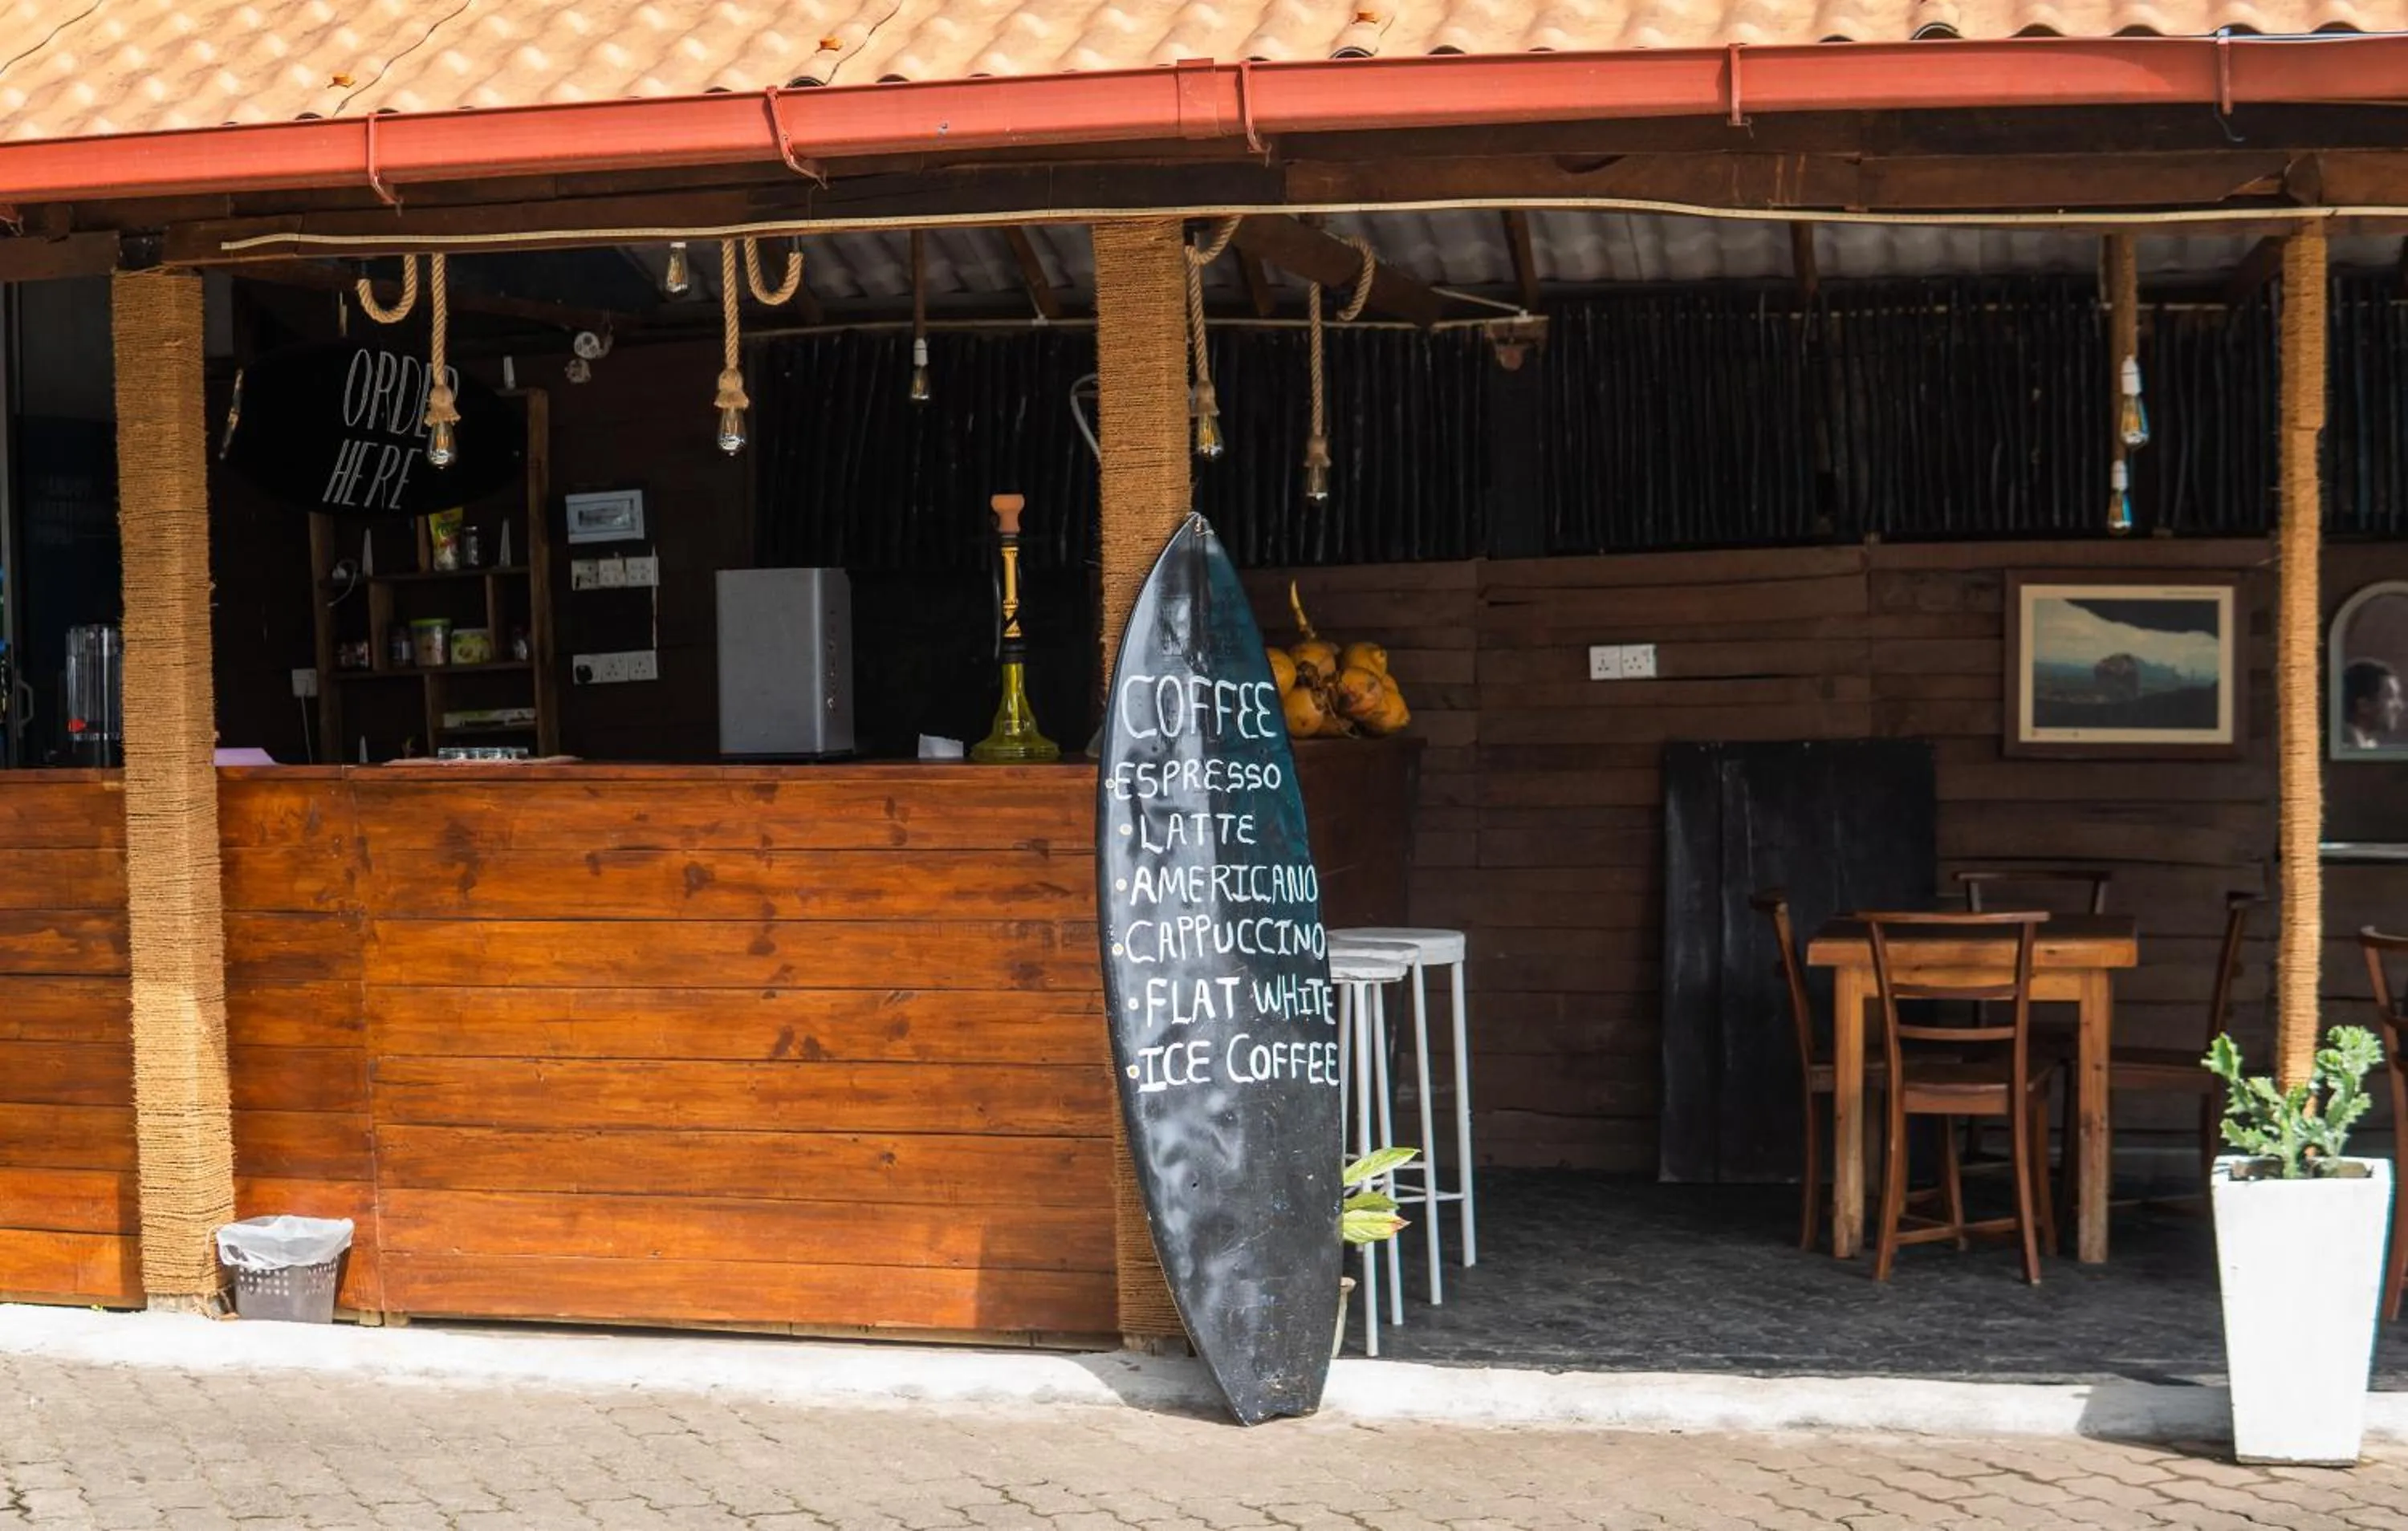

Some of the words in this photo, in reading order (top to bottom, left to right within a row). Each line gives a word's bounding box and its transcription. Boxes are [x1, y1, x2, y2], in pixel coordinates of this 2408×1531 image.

[322, 439, 423, 510] HERE
[1121, 675, 1278, 739] COFFEE
[1113, 758, 1282, 800] ESPRESSO
[1140, 813, 1257, 854] LATTE
[1129, 864, 1319, 906] AMERICANO
[1125, 915, 1326, 963] CAPPUCCINO
[1145, 977, 1240, 1028] FLAT
[1252, 973, 1336, 1025] WHITE
[1137, 1041, 1212, 1093] ICE
[1226, 1034, 1340, 1086] COFFEE
